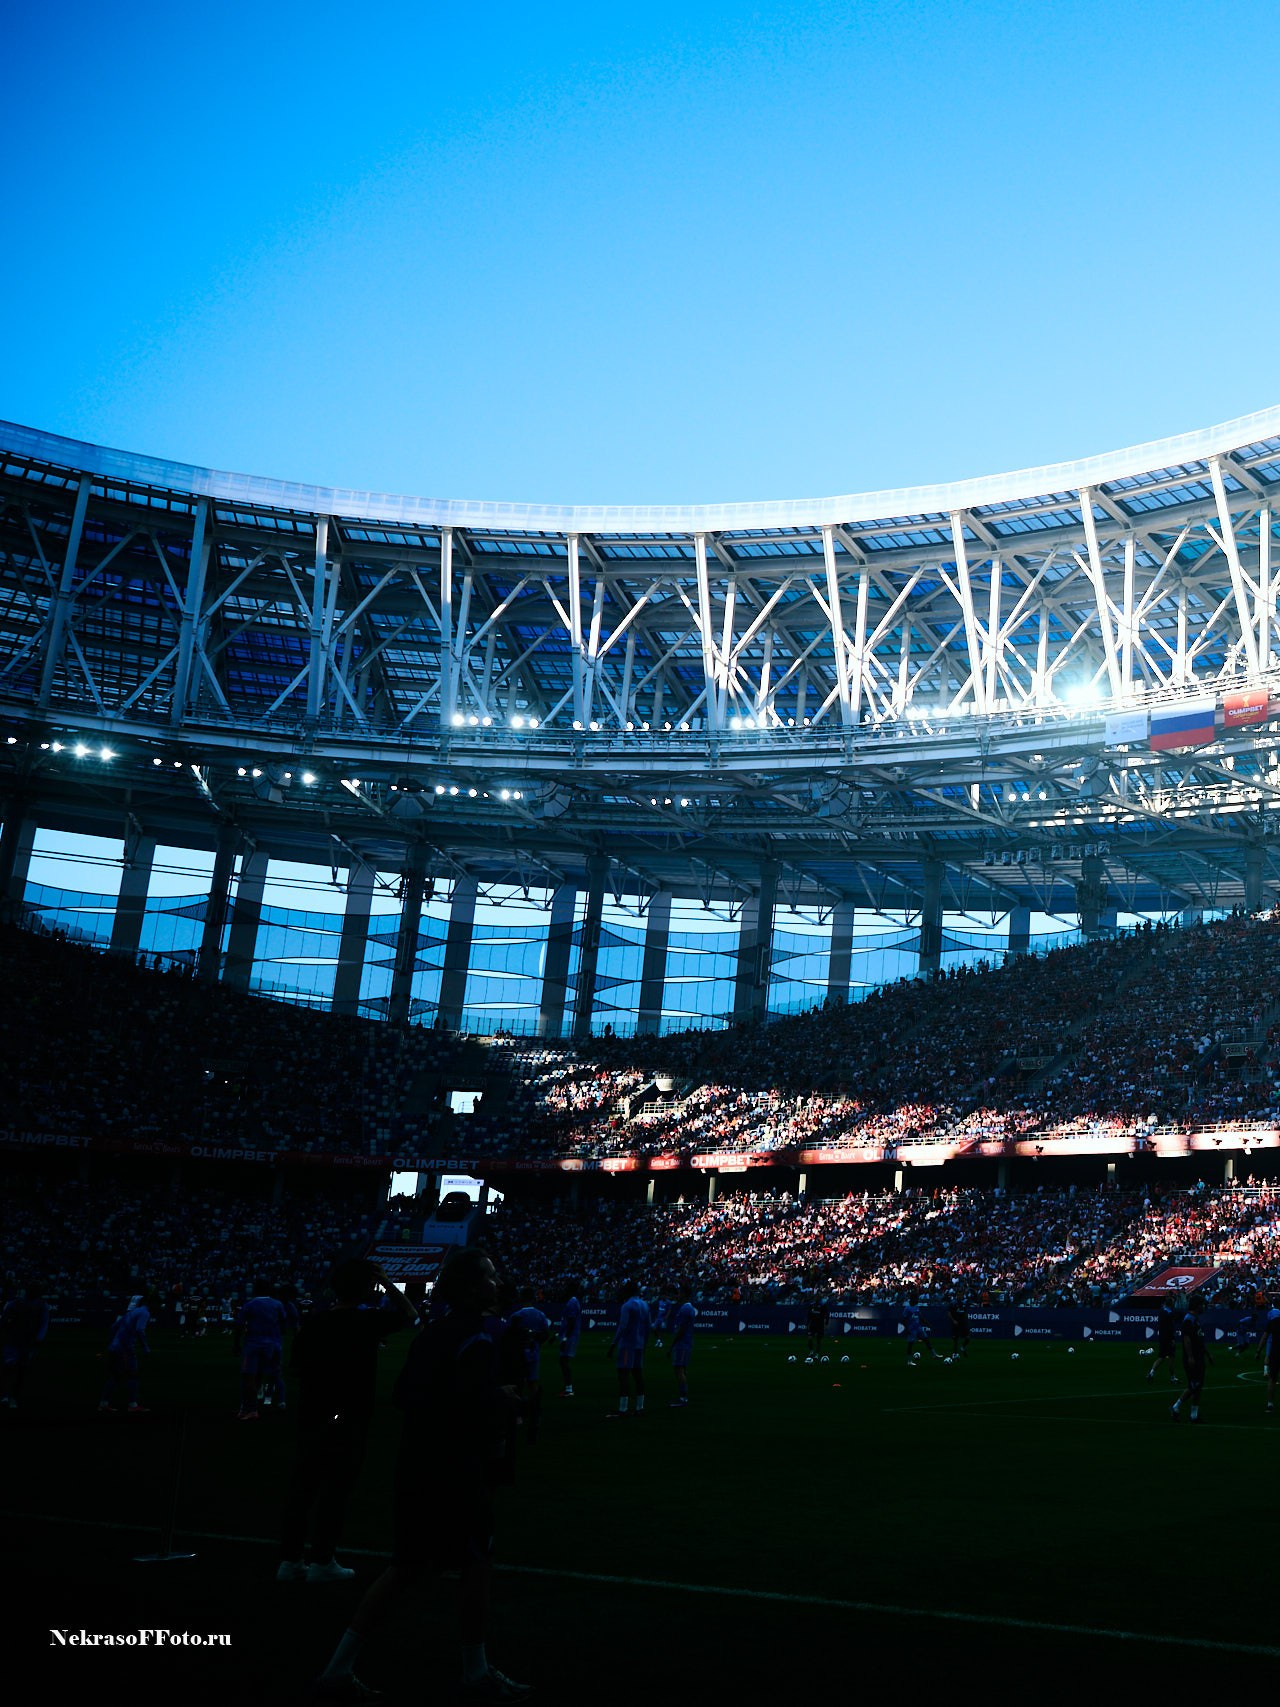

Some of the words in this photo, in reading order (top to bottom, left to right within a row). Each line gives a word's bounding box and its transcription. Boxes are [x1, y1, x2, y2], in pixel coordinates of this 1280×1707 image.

[190, 1145, 279, 1163] OLIMPBET
[393, 1158, 480, 1170] OLIMPBET
[561, 1158, 628, 1171] OLIMPBET
[690, 1154, 751, 1167] OLIMPBET
[829, 1311, 859, 1319] НОВАТЭК
[1123, 1315, 1159, 1323] НОВАТЭК
